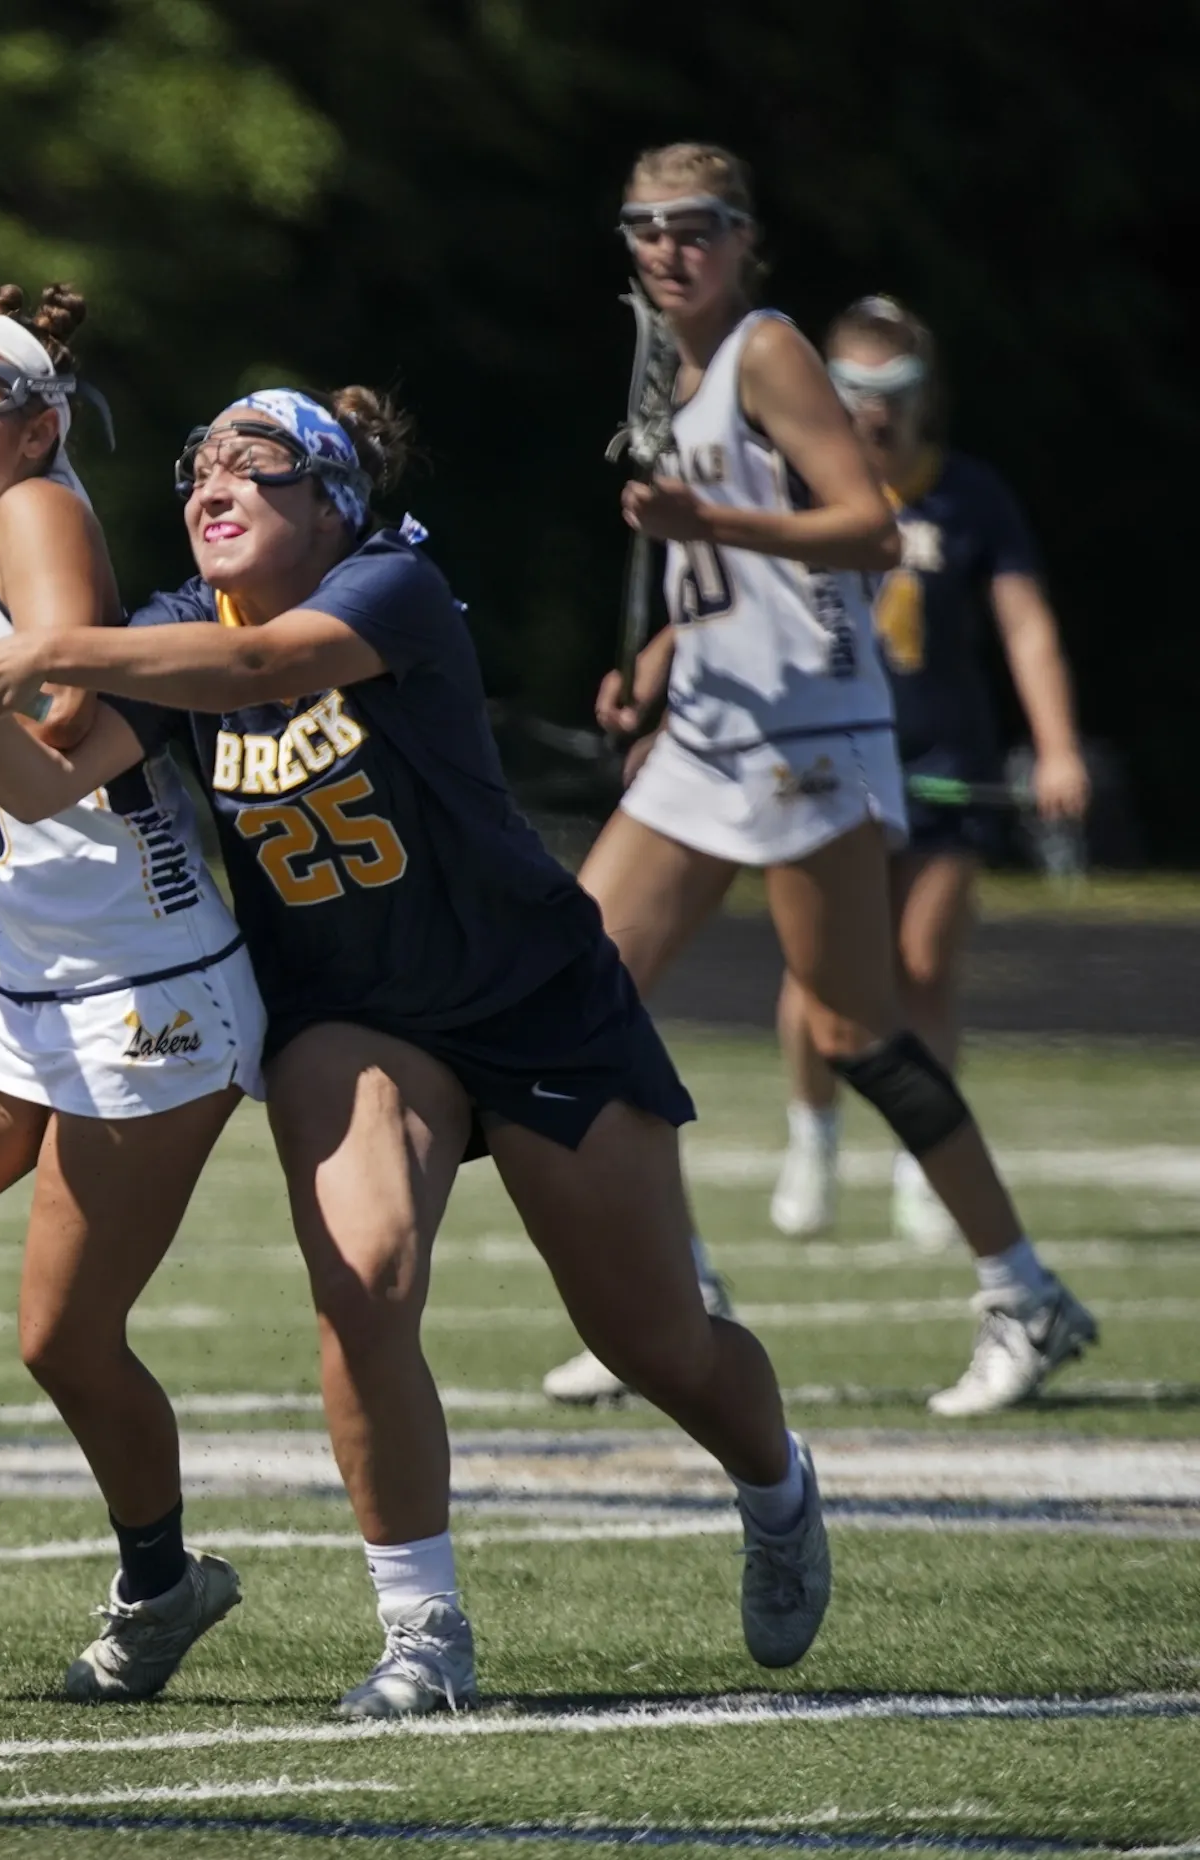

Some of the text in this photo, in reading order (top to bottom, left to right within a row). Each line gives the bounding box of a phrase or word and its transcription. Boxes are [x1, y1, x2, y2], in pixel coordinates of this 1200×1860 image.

[212, 689, 363, 794] BRECK
[234, 768, 408, 906] 25
[122, 1022, 202, 1058] Lakers
